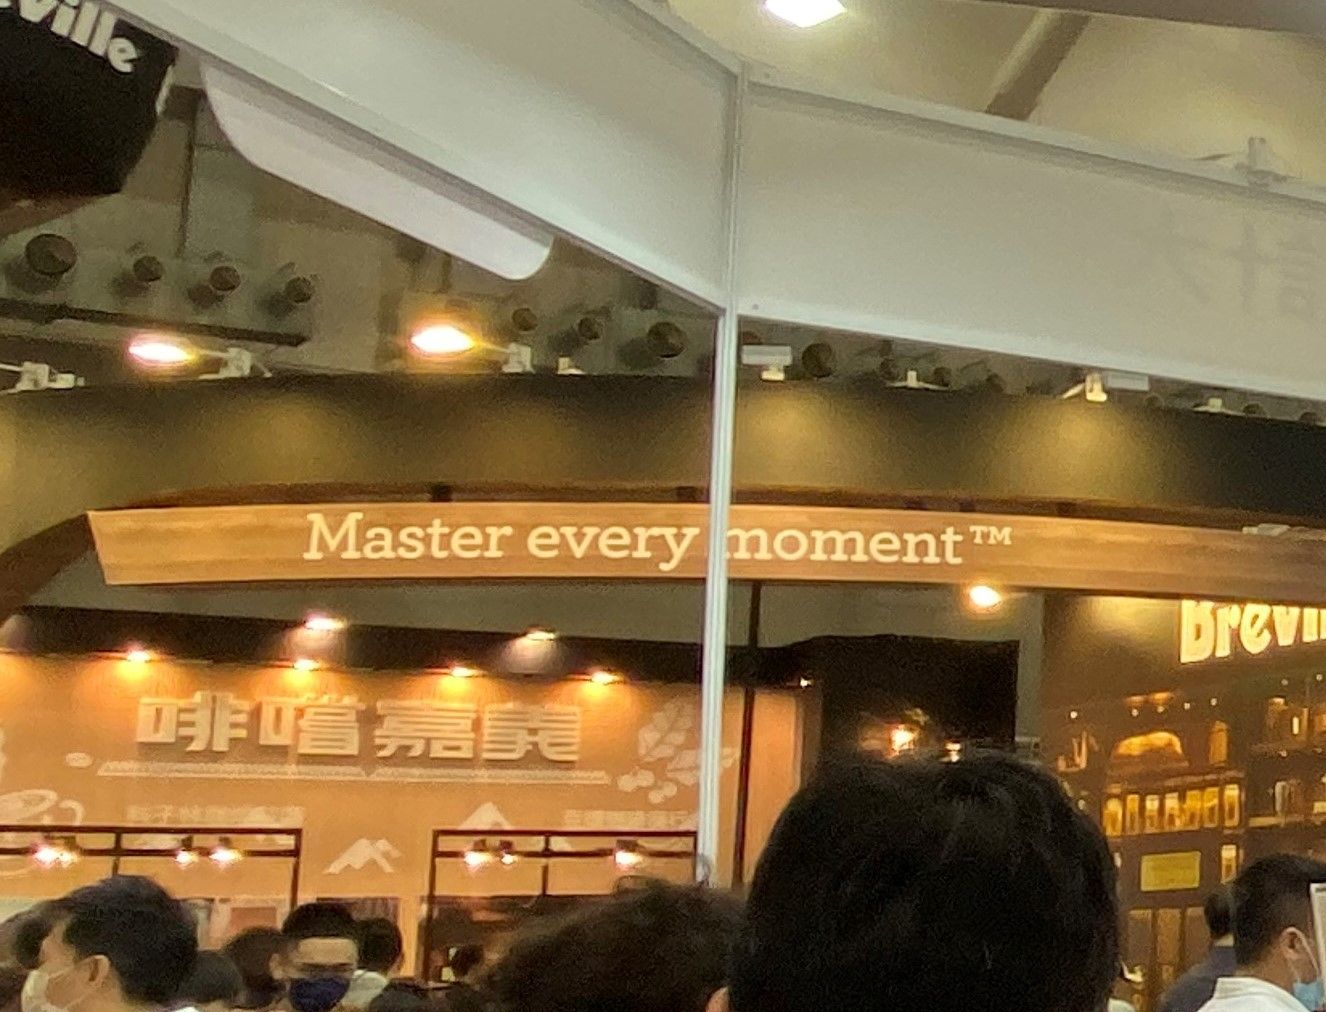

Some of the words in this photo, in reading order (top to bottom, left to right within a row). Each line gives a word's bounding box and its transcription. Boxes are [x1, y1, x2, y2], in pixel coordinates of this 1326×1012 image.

[0, 0, 139, 73] ville
[302, 512, 514, 562] Master
[527, 526, 700, 571] every
